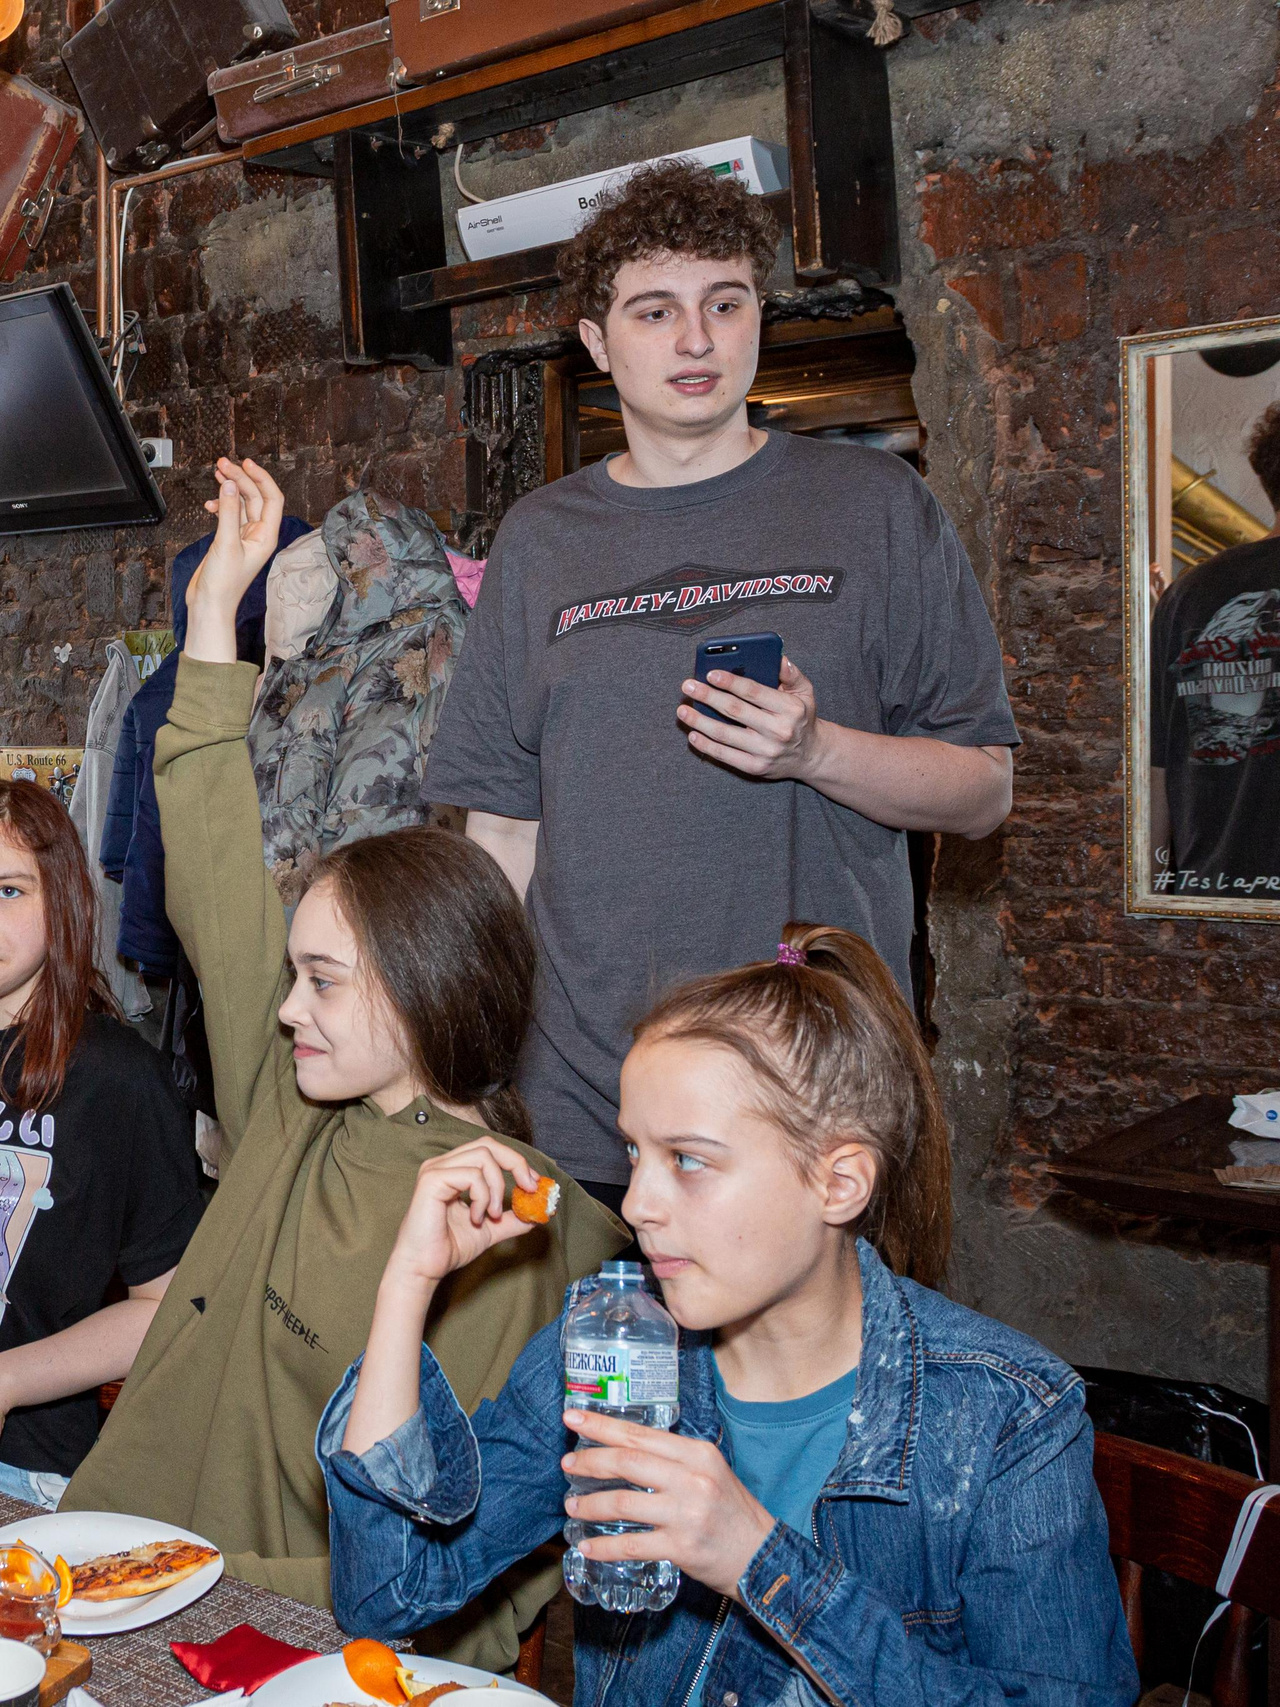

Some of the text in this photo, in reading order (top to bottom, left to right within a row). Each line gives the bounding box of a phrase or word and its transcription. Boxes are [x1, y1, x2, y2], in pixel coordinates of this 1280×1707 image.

[467, 215, 503, 230] AirShell
[555, 574, 834, 637] HARLEY-DAVIDSON
[6, 754, 67, 766] U.S. Route 66
